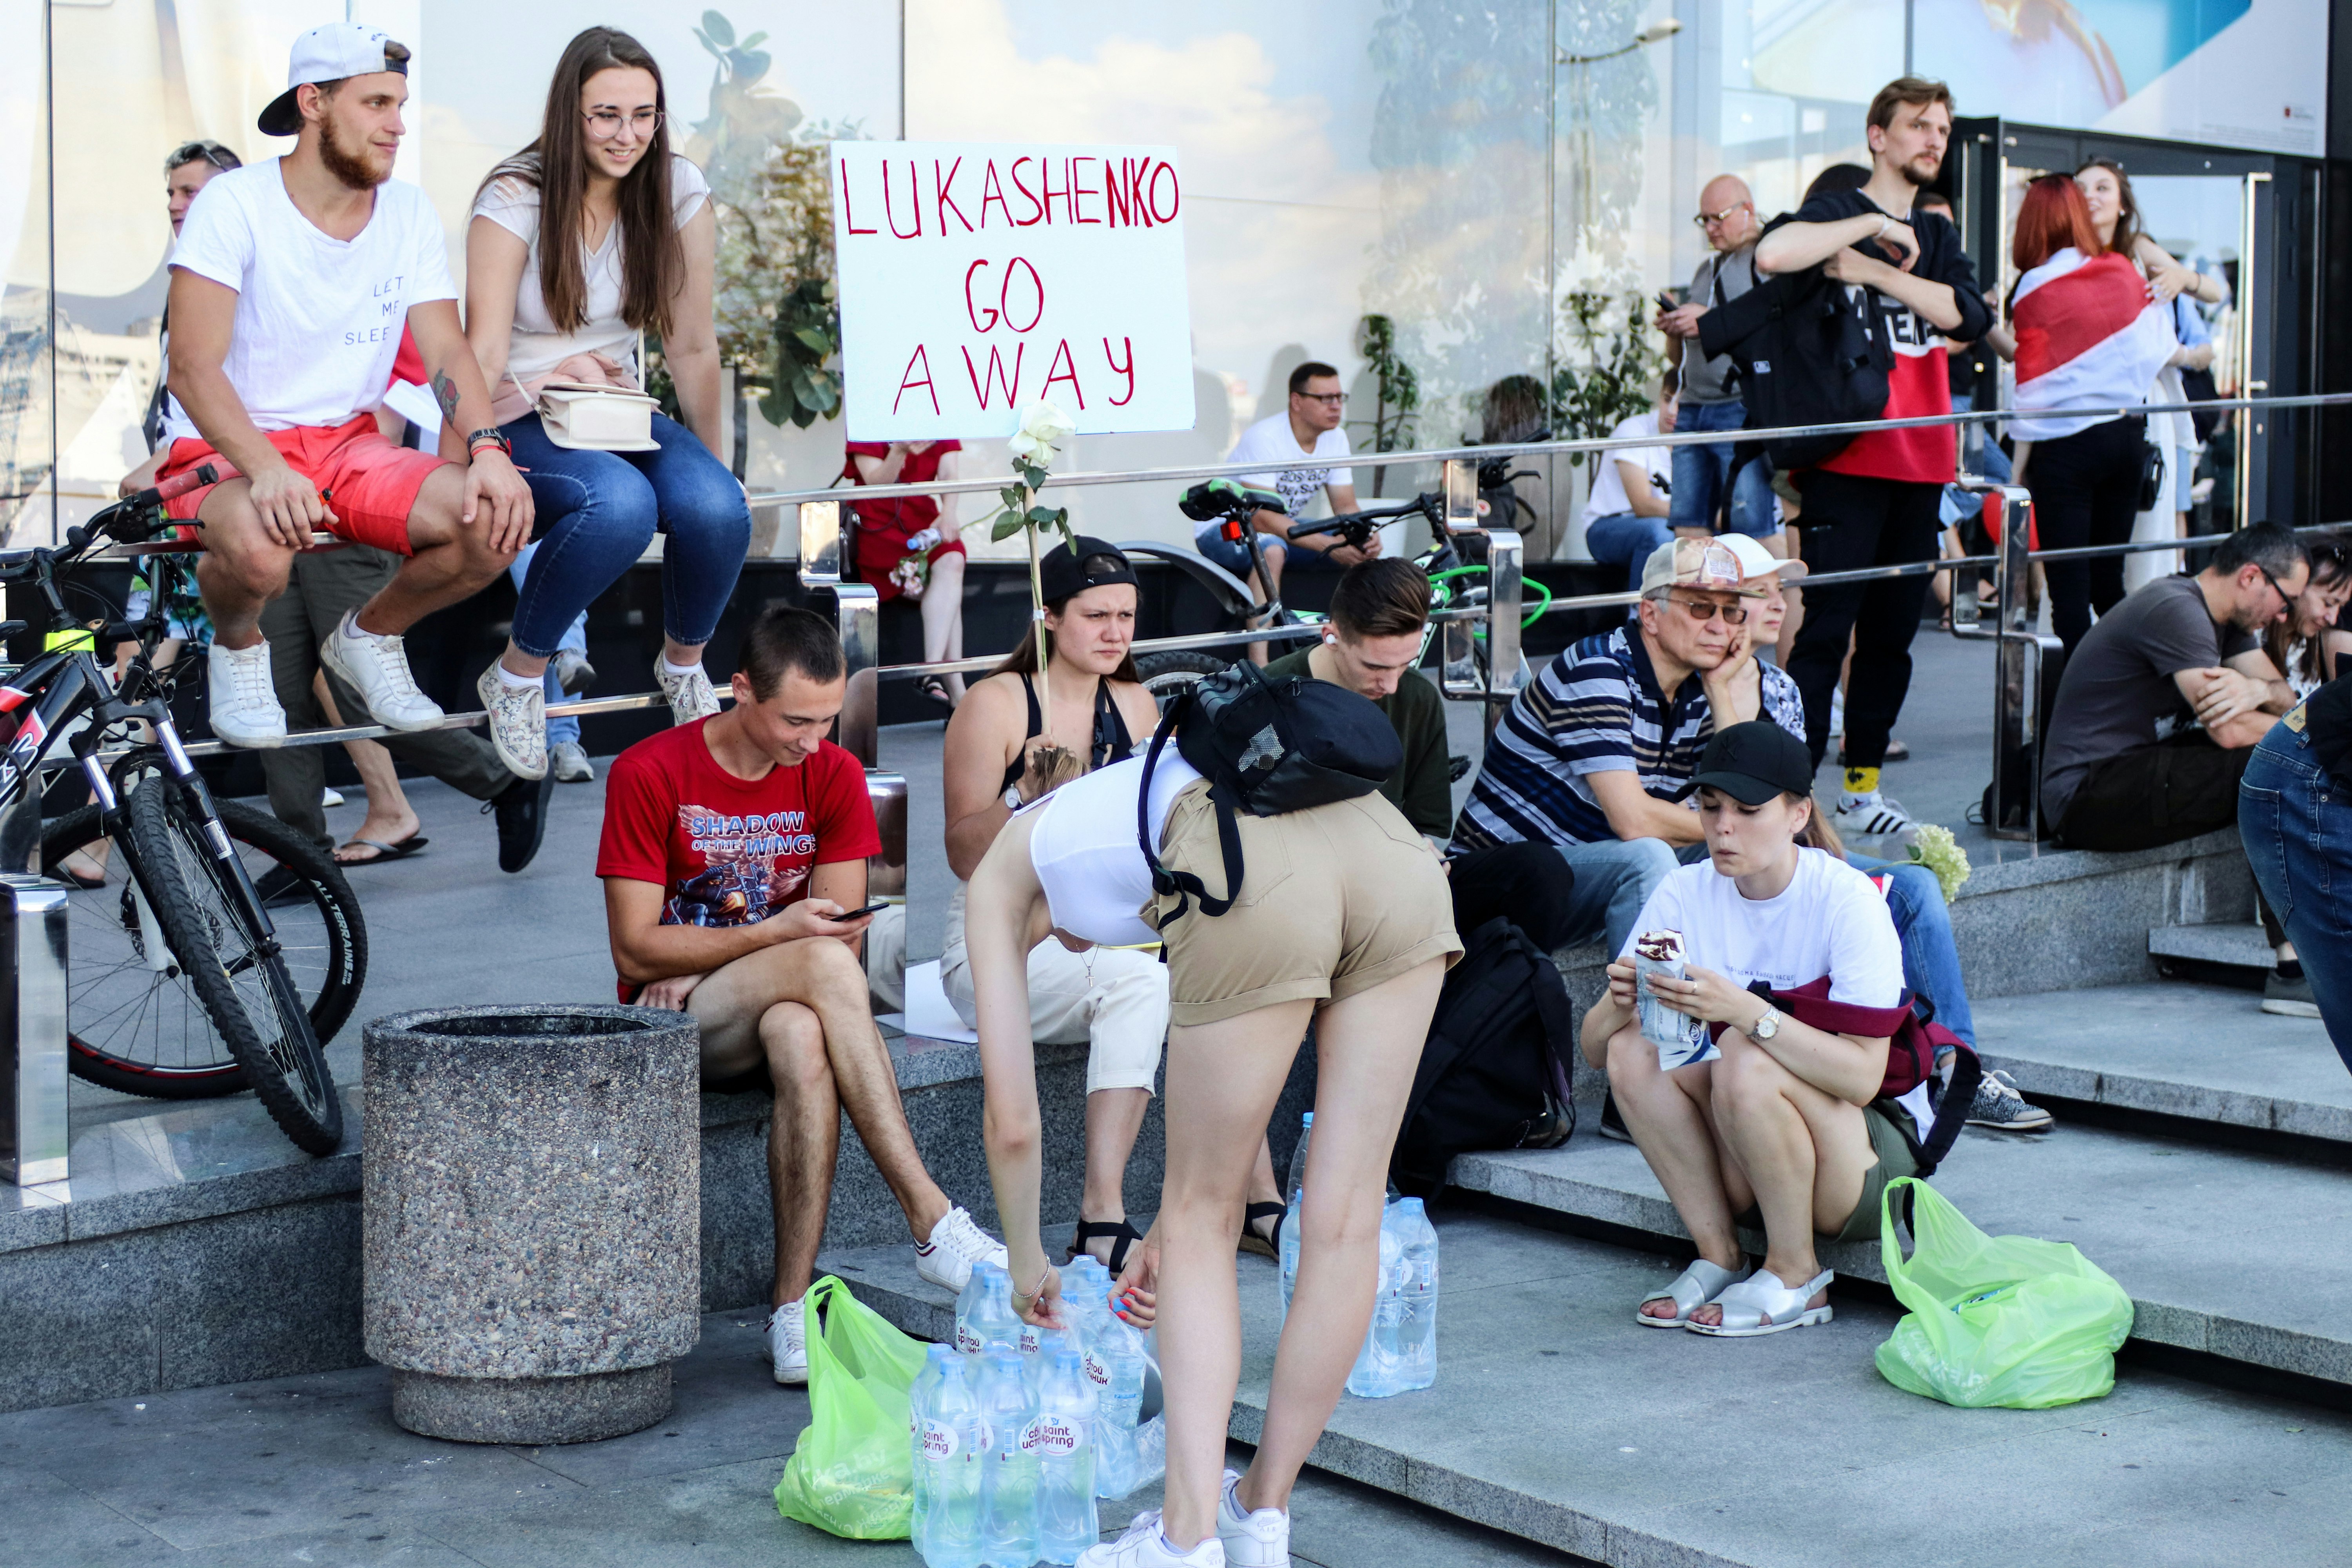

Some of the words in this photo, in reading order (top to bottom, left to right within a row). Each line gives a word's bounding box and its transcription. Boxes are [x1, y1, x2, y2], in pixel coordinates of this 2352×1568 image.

[841, 156, 1179, 239] LUKASHENKO
[374, 276, 404, 297] LET
[965, 256, 1044, 333] GO
[382, 300, 399, 316] ME
[345, 327, 390, 345] SLEE
[893, 337, 1134, 416] AWAY
[691, 811, 805, 837] SHADOW
[691, 840, 710, 851] OF
[710, 839, 741, 850] THE
[310, 878, 333, 903] ALL
[330, 903, 354, 972] TERRAINS
[1042, 1434, 1074, 1448] spring
[1044, 1425, 1070, 1436] saint
